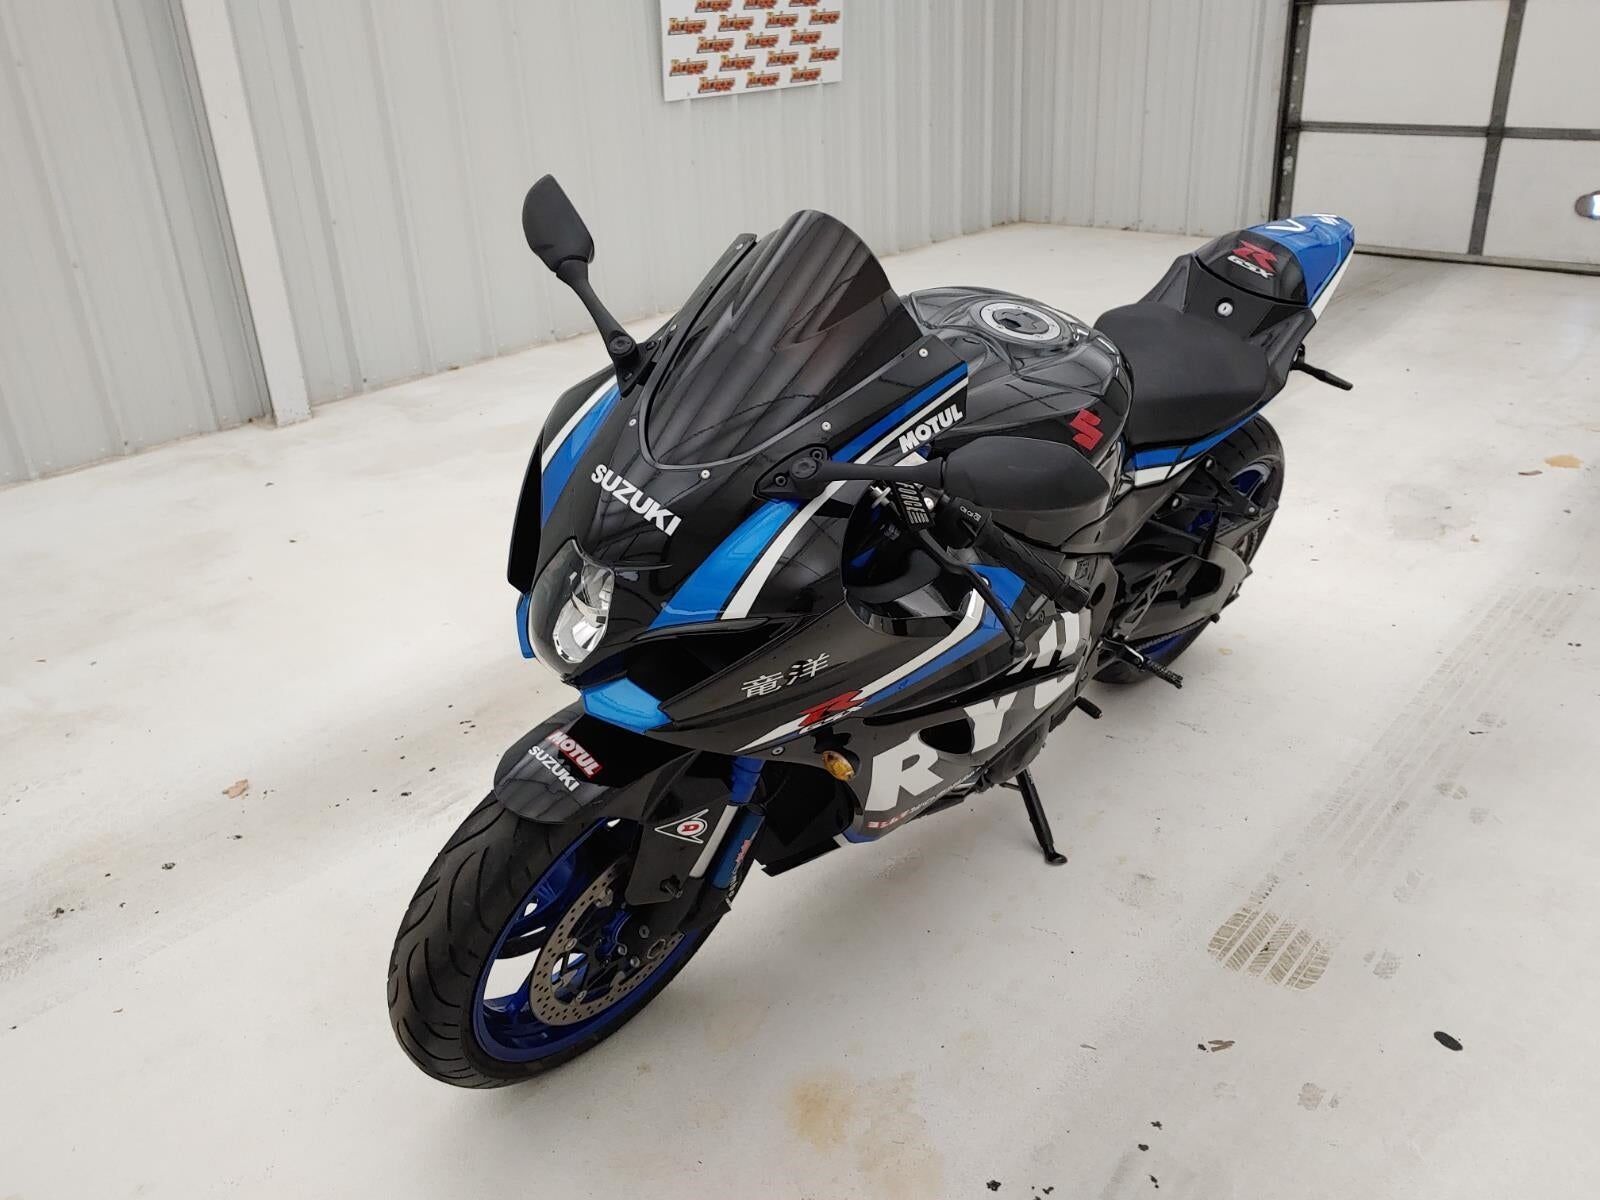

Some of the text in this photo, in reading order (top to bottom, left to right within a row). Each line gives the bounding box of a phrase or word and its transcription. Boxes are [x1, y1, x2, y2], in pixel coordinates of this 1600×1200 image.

[899, 404, 963, 453] MOTUL
[591, 464, 682, 536] SUZUKI
[895, 481, 930, 524] FORCE
[528, 745, 580, 792] SUZUKI
[548, 729, 601, 776] MOTUL
